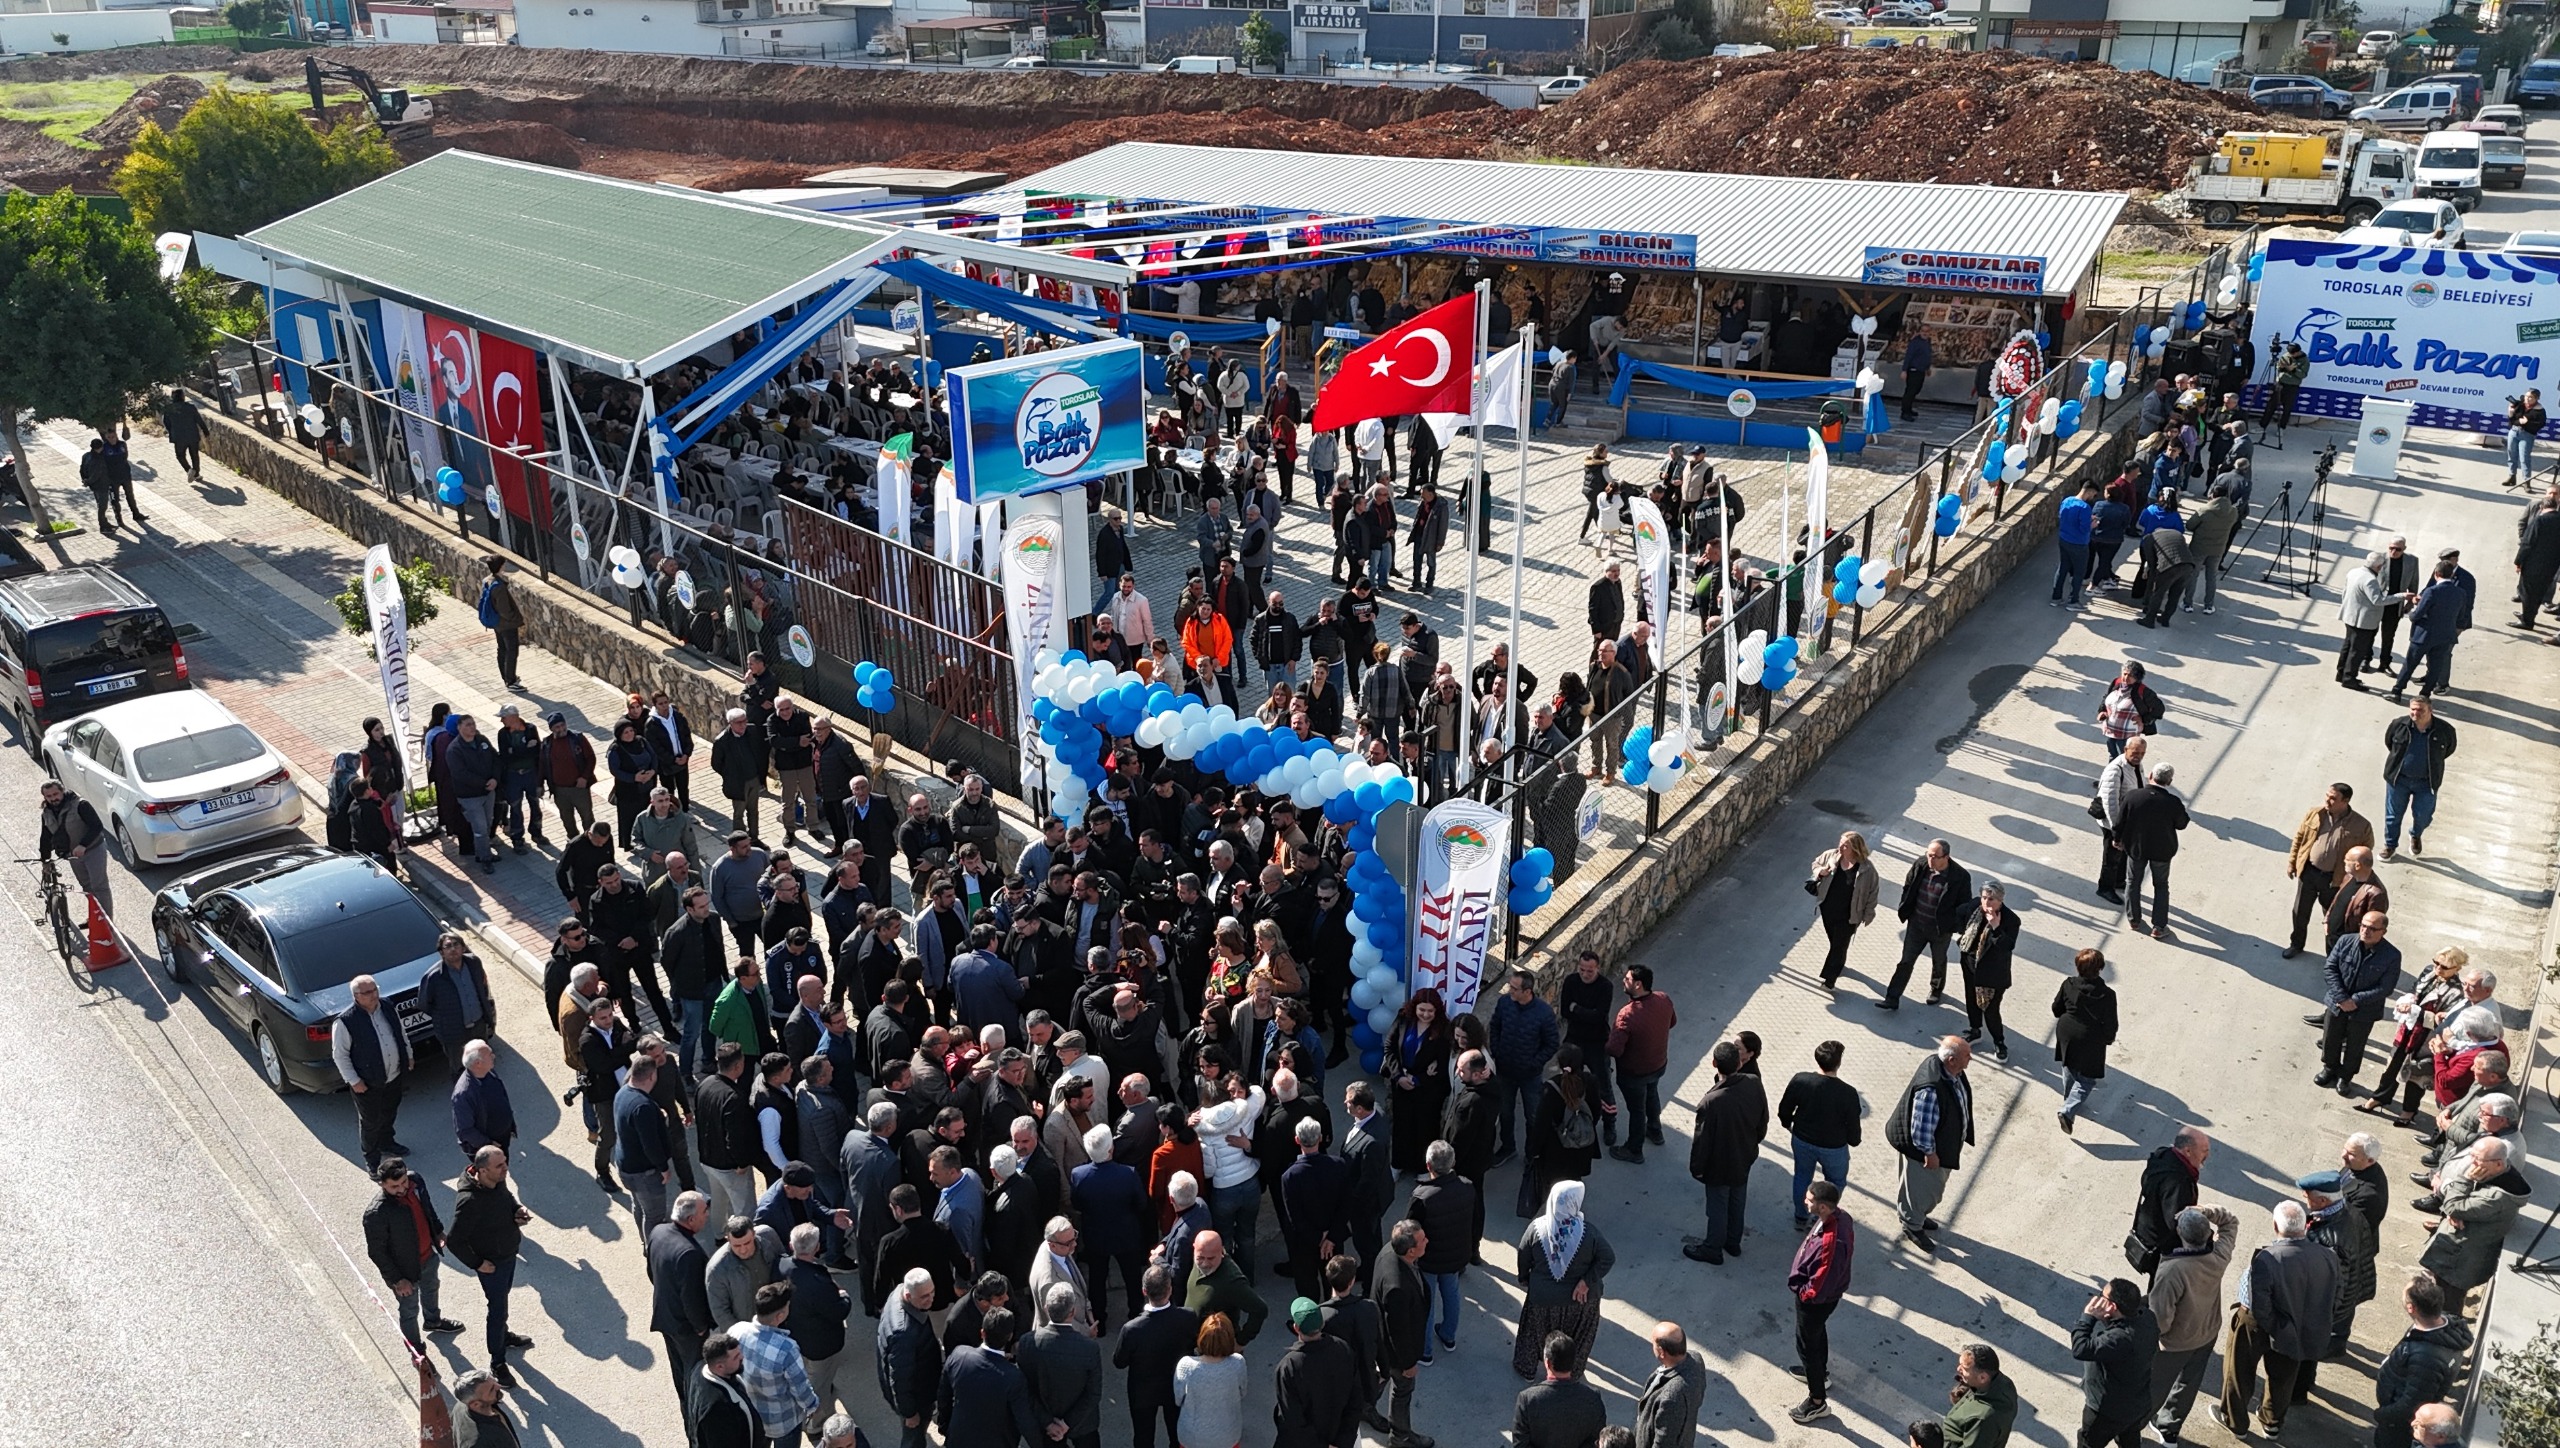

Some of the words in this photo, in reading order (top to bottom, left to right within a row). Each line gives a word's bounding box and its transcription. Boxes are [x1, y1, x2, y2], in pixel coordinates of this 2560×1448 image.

[1305, 5, 1356, 16] memo
[1300, 16, 1361, 28] KIRTASİYE
[1599, 233, 1673, 250] BİLGİN
[1579, 248, 1691, 267] BALIKÇILIK
[1866, 251, 1898, 268] DOĞA
[1901, 253, 2040, 274] CAMUZLAR
[1906, 271, 2037, 292] BALIKÇILIK
[2323, 279, 2403, 297] TOROSLAR
[2443, 289, 2533, 307] BELEDİYESİ
[2347, 318, 2391, 328] TOROSLAR
[2309, 331, 2402, 369] Balık
[2413, 338, 2541, 380] Pazarı
[2327, 374, 2384, 387] TOROSLAR'DA
[2389, 380, 2415, 390] İLKLER
[2420, 384, 2450, 393] DEVAM
[2452, 386, 2485, 397] EDİYOR
[1061, 390, 1095, 407] TOROSLAR
[1038, 410, 1092, 446] Balık
[1023, 434, 1091, 467] Pazarı
[94, 685, 103, 693] 33
[124, 679, 134, 687] 94
[207, 800, 218, 810] 33
[220, 797, 234, 808] AUZ
[237, 791, 252, 802] 912
[1455, 888, 1492, 1008] AZARI
[402, 1012, 426, 1028] CAK
